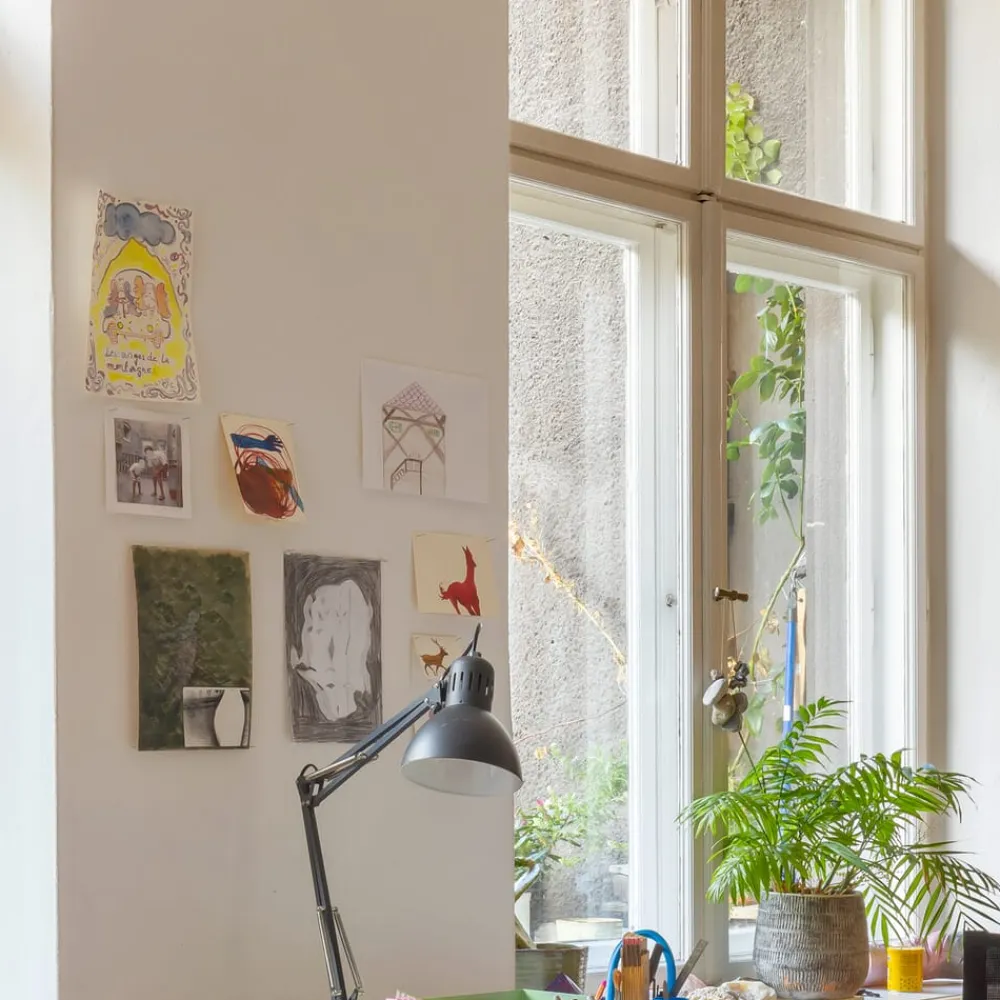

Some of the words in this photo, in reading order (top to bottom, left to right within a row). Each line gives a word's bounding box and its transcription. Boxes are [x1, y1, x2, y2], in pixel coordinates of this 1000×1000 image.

[121, 352, 145, 366] anges
[146, 351, 158, 362] de
[160, 353, 170, 364] la
